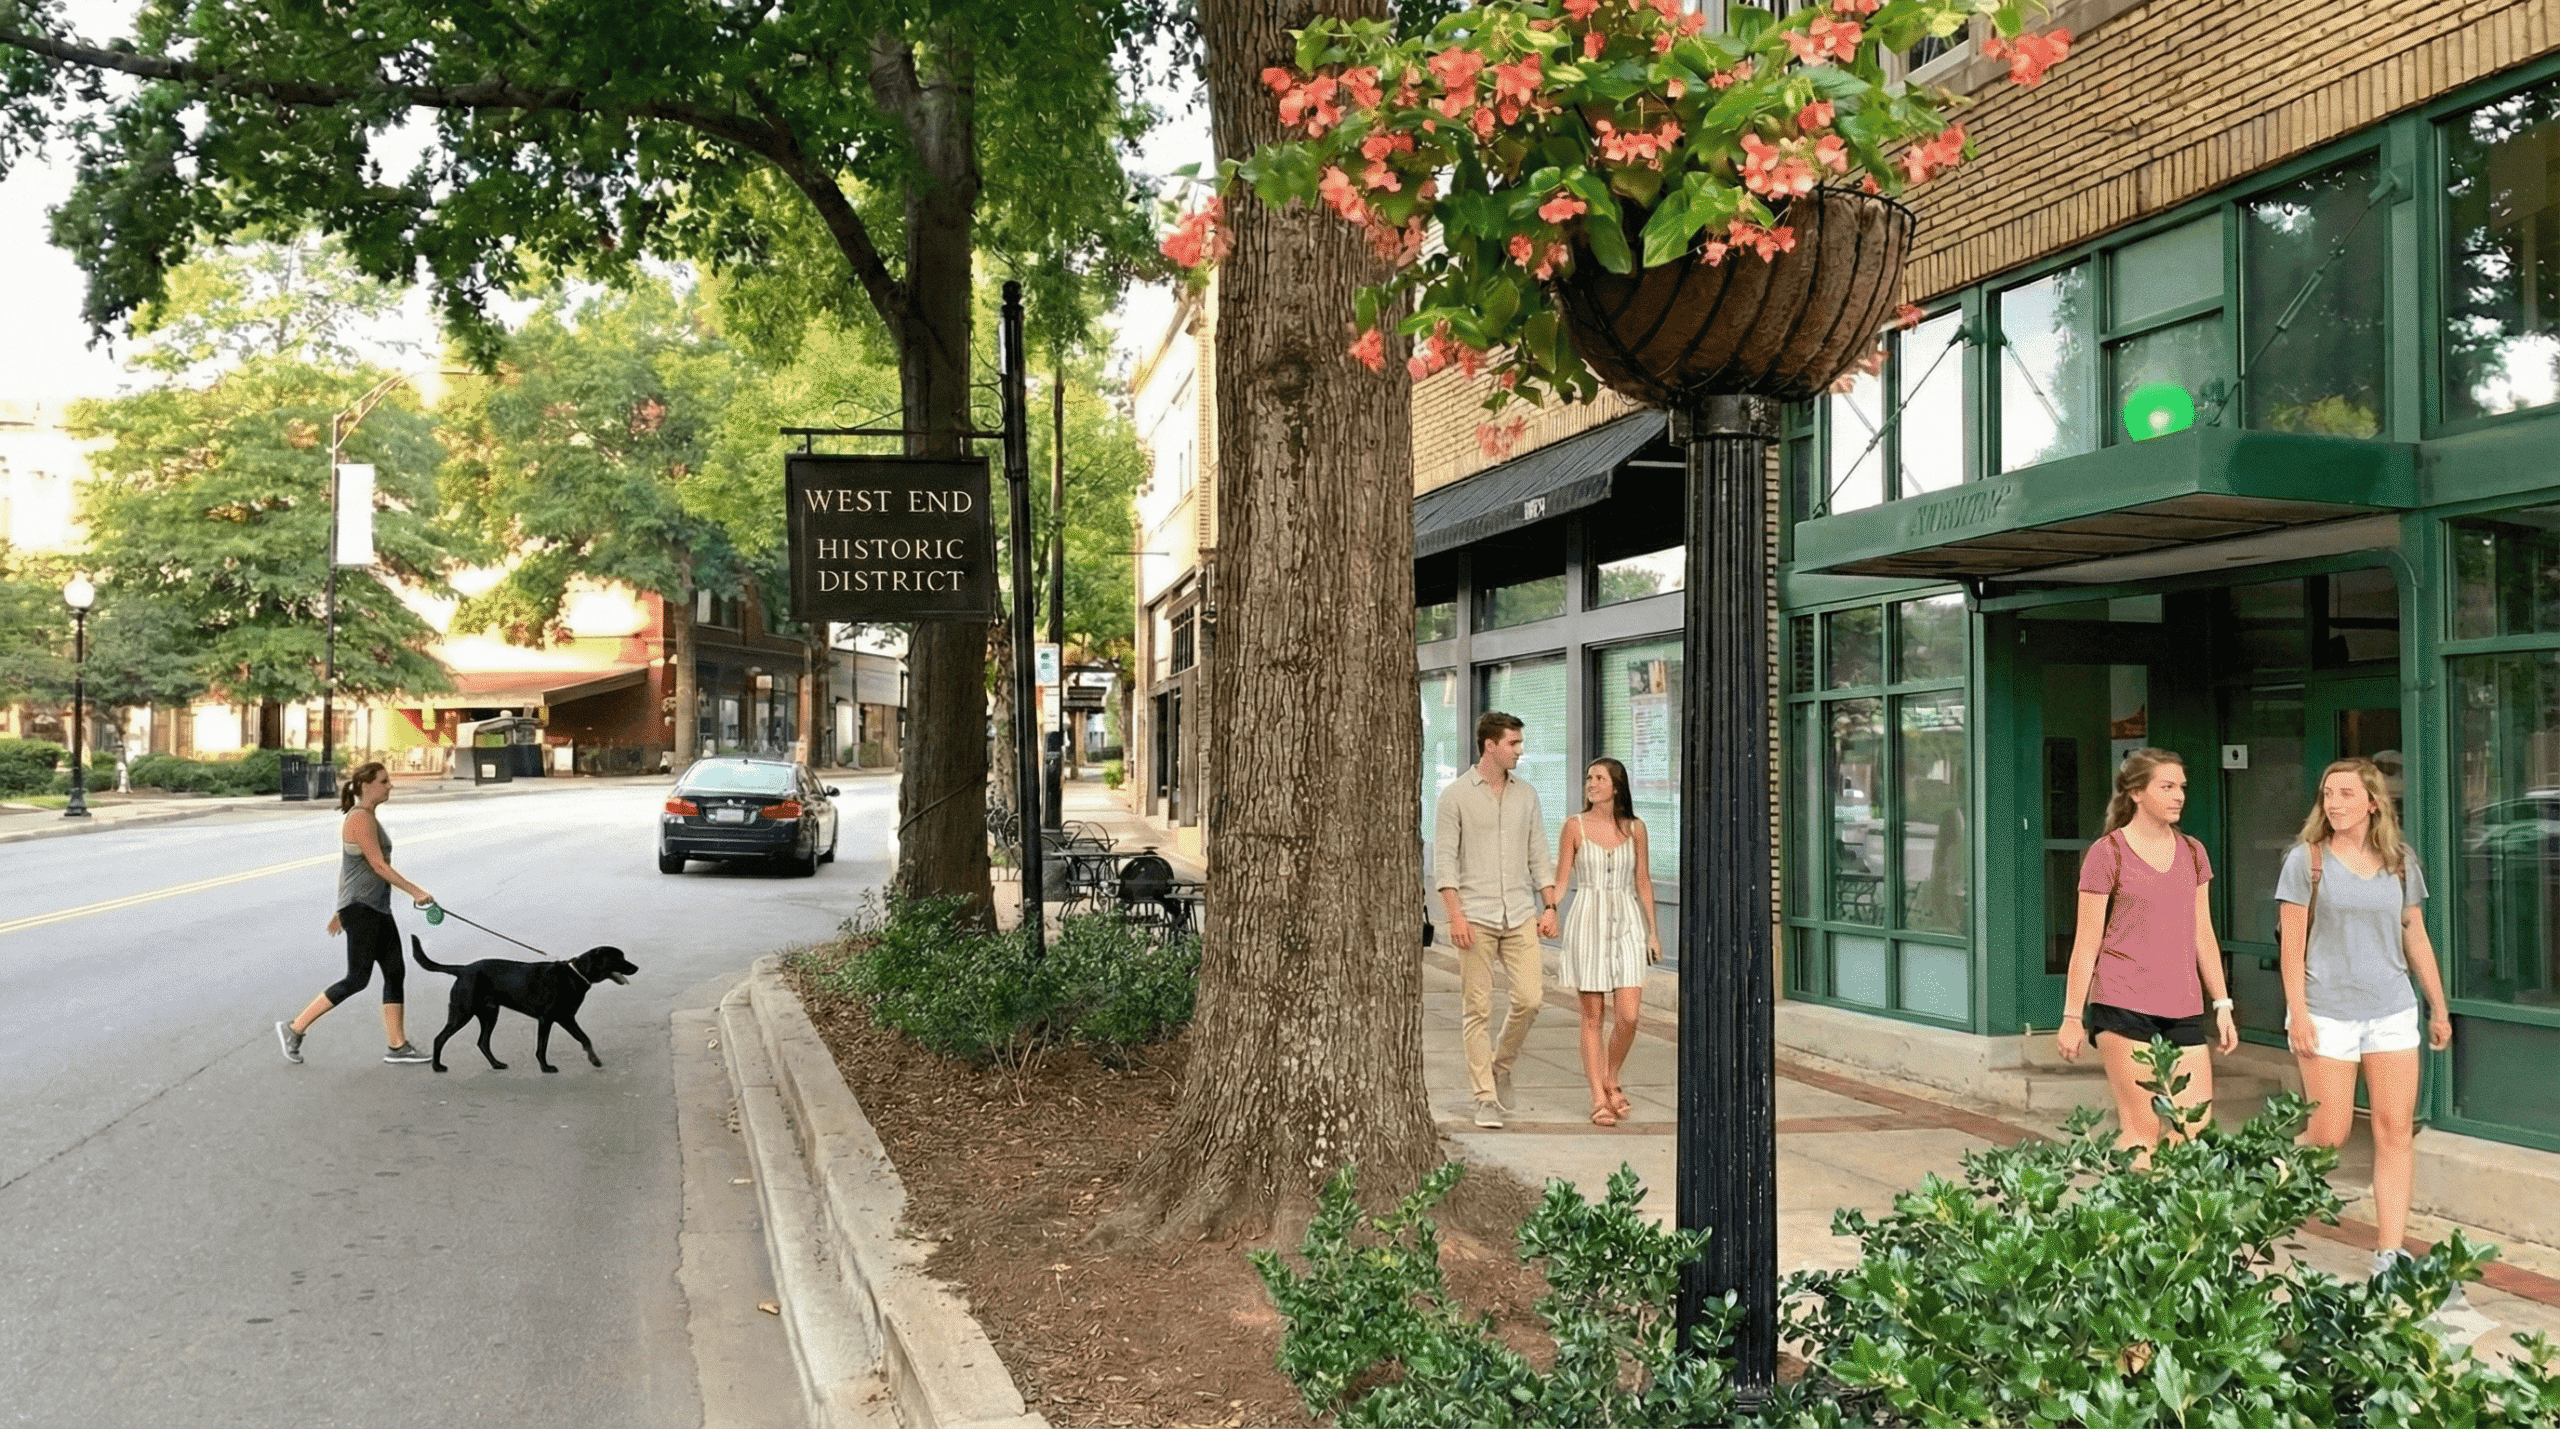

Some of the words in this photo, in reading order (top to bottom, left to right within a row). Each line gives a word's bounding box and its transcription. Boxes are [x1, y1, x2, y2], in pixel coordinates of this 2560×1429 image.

[804, 488, 893, 514] WEST
[908, 490, 973, 514] END
[817, 538, 965, 560] HISTORIC
[817, 570, 965, 592] DISTRICT
